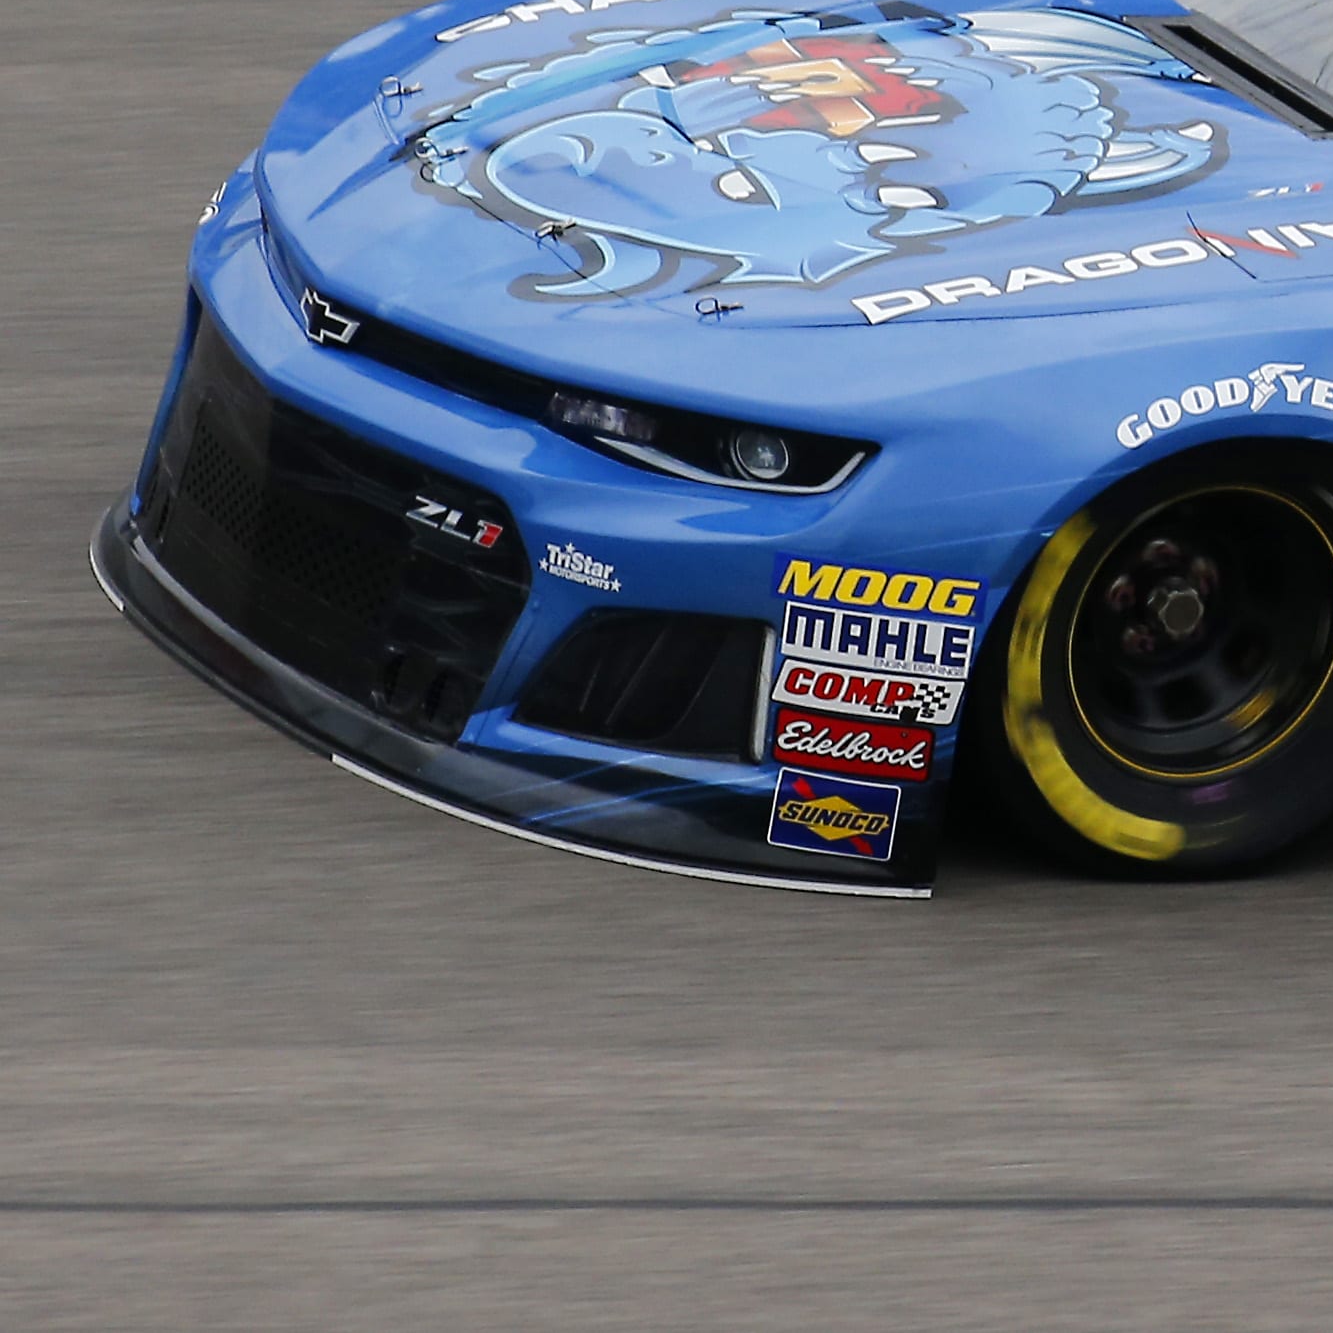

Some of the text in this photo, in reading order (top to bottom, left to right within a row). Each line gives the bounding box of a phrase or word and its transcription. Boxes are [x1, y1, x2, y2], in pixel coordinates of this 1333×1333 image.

[405, 495, 504, 548] ZL1
[547, 543, 614, 580] TriStar
[777, 559, 981, 616] MOOG
[785, 604, 972, 667] MAHLE
[784, 666, 916, 707] COMP
[777, 720, 927, 769] Edelbrock
[781, 801, 888, 834] SUNOCO
